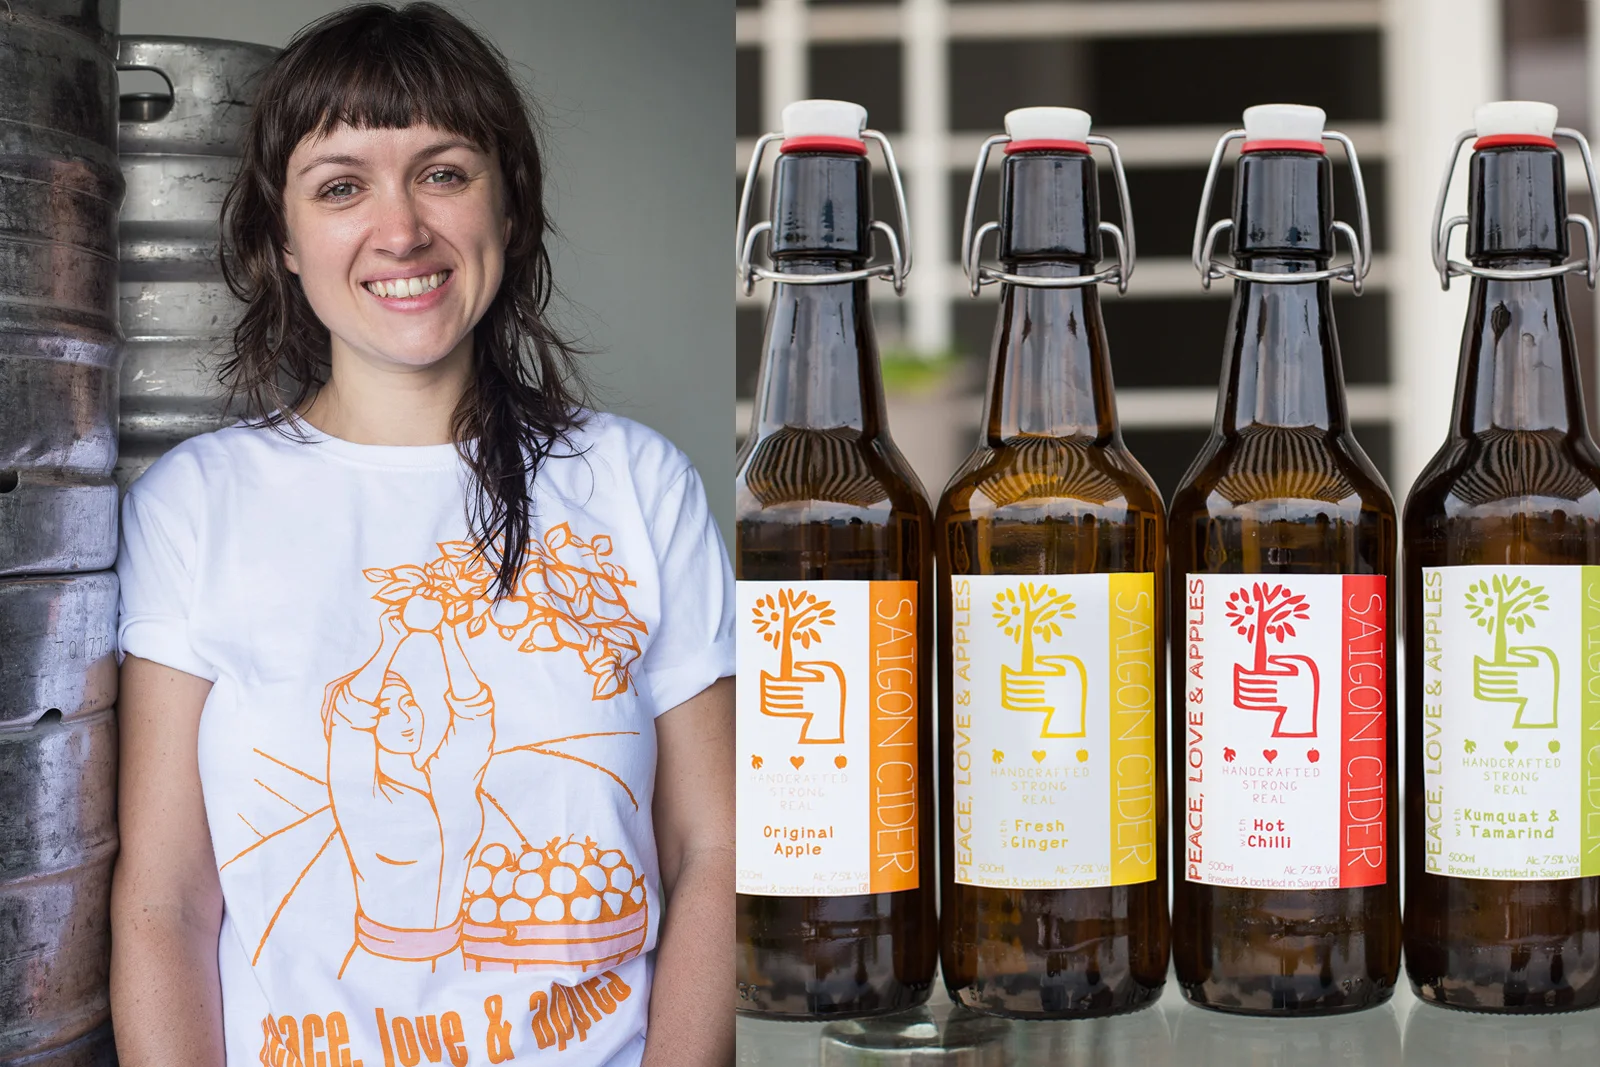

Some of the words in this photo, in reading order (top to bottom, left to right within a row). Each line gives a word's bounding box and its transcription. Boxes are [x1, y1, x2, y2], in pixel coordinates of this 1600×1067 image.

[1189, 579, 1204, 679] APPLES
[1425, 572, 1442, 672] APPLES
[955, 579, 971, 681] APPLES
[1115, 591, 1152, 741] SAIGON
[1348, 593, 1383, 743] SAIGON
[876, 599, 914, 749] SAIGON
[1426, 680, 1442, 695] &
[956, 690, 970, 706] &
[1189, 689, 1203, 704] &
[1425, 704, 1442, 774] LOVE
[956, 714, 972, 785] LOVE
[1189, 712, 1203, 782] LOVE
[1463, 758, 1560, 768] HANDCRAFTED
[991, 767, 1089, 778] HANDCRAFTED
[1223, 767, 1320, 777] HANDCRAFTED
[1484, 771, 1538, 781] STRONG
[1012, 781, 1066, 791] STRONG
[1243, 780, 1297, 791] STRONG
[1494, 784, 1527, 795] REAL
[1022, 794, 1054, 804] REAL
[1253, 794, 1285, 803] REAL
[876, 761, 916, 873] CIDER
[1117, 754, 1153, 865] CIDER
[1347, 755, 1384, 868] CIDER
[1464, 809, 1538, 825] Kumquat
[1548, 810, 1559, 822] &
[1015, 820, 1064, 832] Fresh
[1254, 819, 1284, 831] Hot
[1427, 786, 1444, 872] PEACE,
[1470, 825, 1554, 838] Tamarind
[764, 826, 833, 841] Original
[955, 797, 973, 883] PEACE,
[1189, 794, 1204, 880] PEACE,
[1011, 836, 1068, 851] Ginger
[1248, 835, 1290, 848] Chilli
[774, 843, 821, 858] Apple
[1449, 852, 1475, 863] 500ml
[1208, 861, 1233, 872] 500ml
[1526, 856, 1540, 865] Alc
[1565, 855, 1580, 863] Vol
[979, 864, 1004, 873] 500ml
[1284, 866, 1296, 875] Alc
[1325, 866, 1338, 874] Vol
[1448, 865, 1480, 875] Brewed
[1482, 868, 1490, 876] &
[1492, 869, 1528, 877] bottled
[1539, 868, 1569, 879] Saigon
[1207, 873, 1238, 885] Brewed
[1241, 877, 1248, 885] &
[1249, 879, 1285, 887] bottled
[1297, 879, 1327, 889] Saigon
[375, 1007, 469, 1067] love
[483, 994, 515, 1065] &
